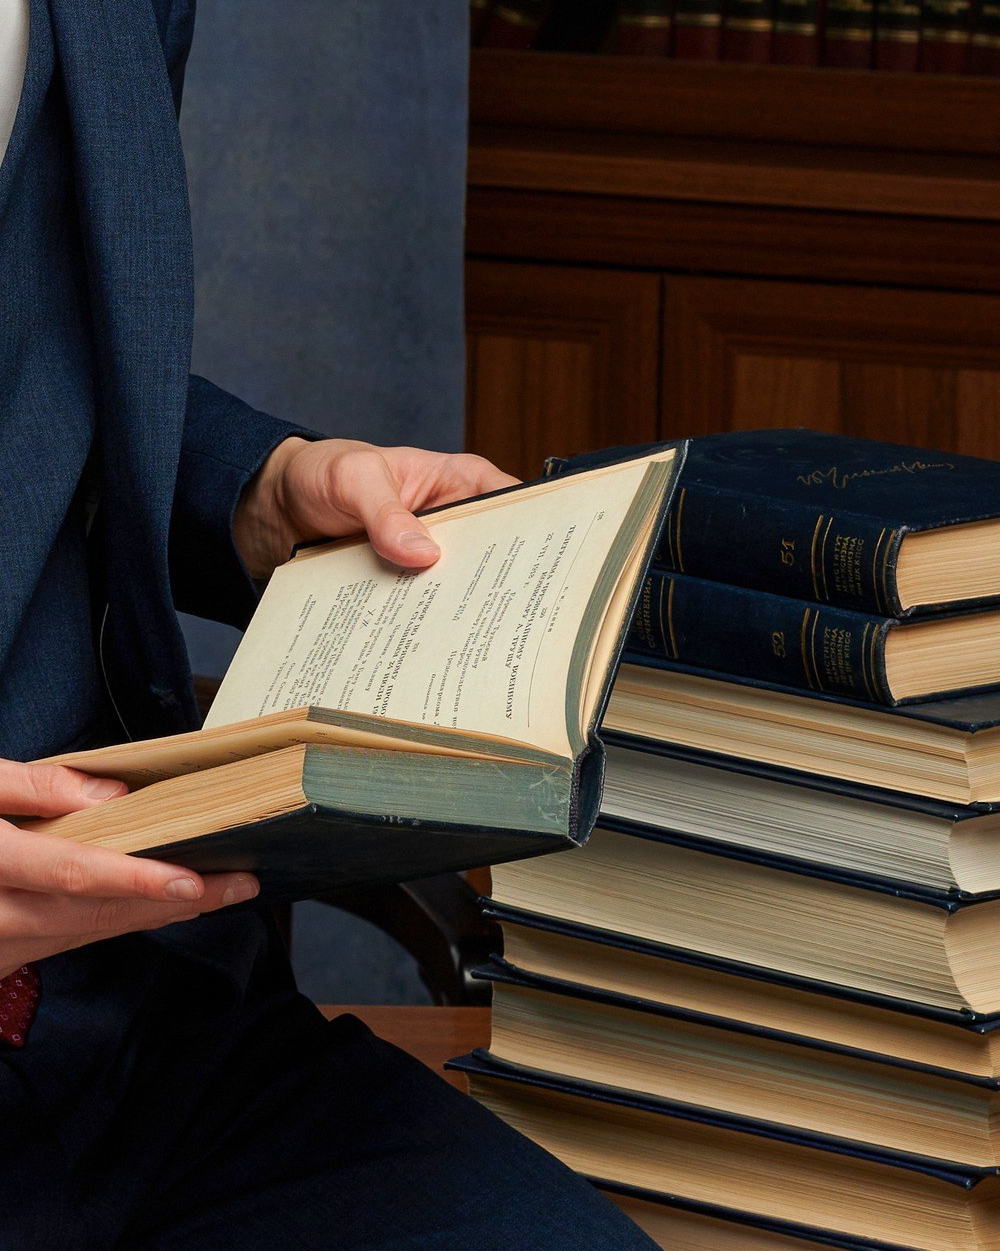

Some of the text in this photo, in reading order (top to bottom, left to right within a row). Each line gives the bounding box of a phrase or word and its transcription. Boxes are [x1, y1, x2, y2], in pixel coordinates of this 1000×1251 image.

[781, 538, 795, 566] 51
[840, 536, 850, 592] МАРКСИЗМА
[854, 539, 865, 565] КПСС
[417, 583, 440, 621] РАЗГОВОР
[521, 571, 547, 618] КОМИССАРУ
[392, 611, 419, 656] СТАЛИНЫМ
[505, 524, 576, 719] ТЕЛЕГРАММА ЧРЕЗВЫЧАЙНОМУ ВОЕННОМУ
[390, 639, 412, 679] ПРЯМОМУ
[504, 635, 519, 668] ТРУШУ
[772, 631, 786, 658] 52
[844, 631, 852, 658] КПСС
[364, 660, 383, 691] Сталину
[375, 673, 389, 700] ИЮЛЯ
[342, 688, 354, 709] тольк
